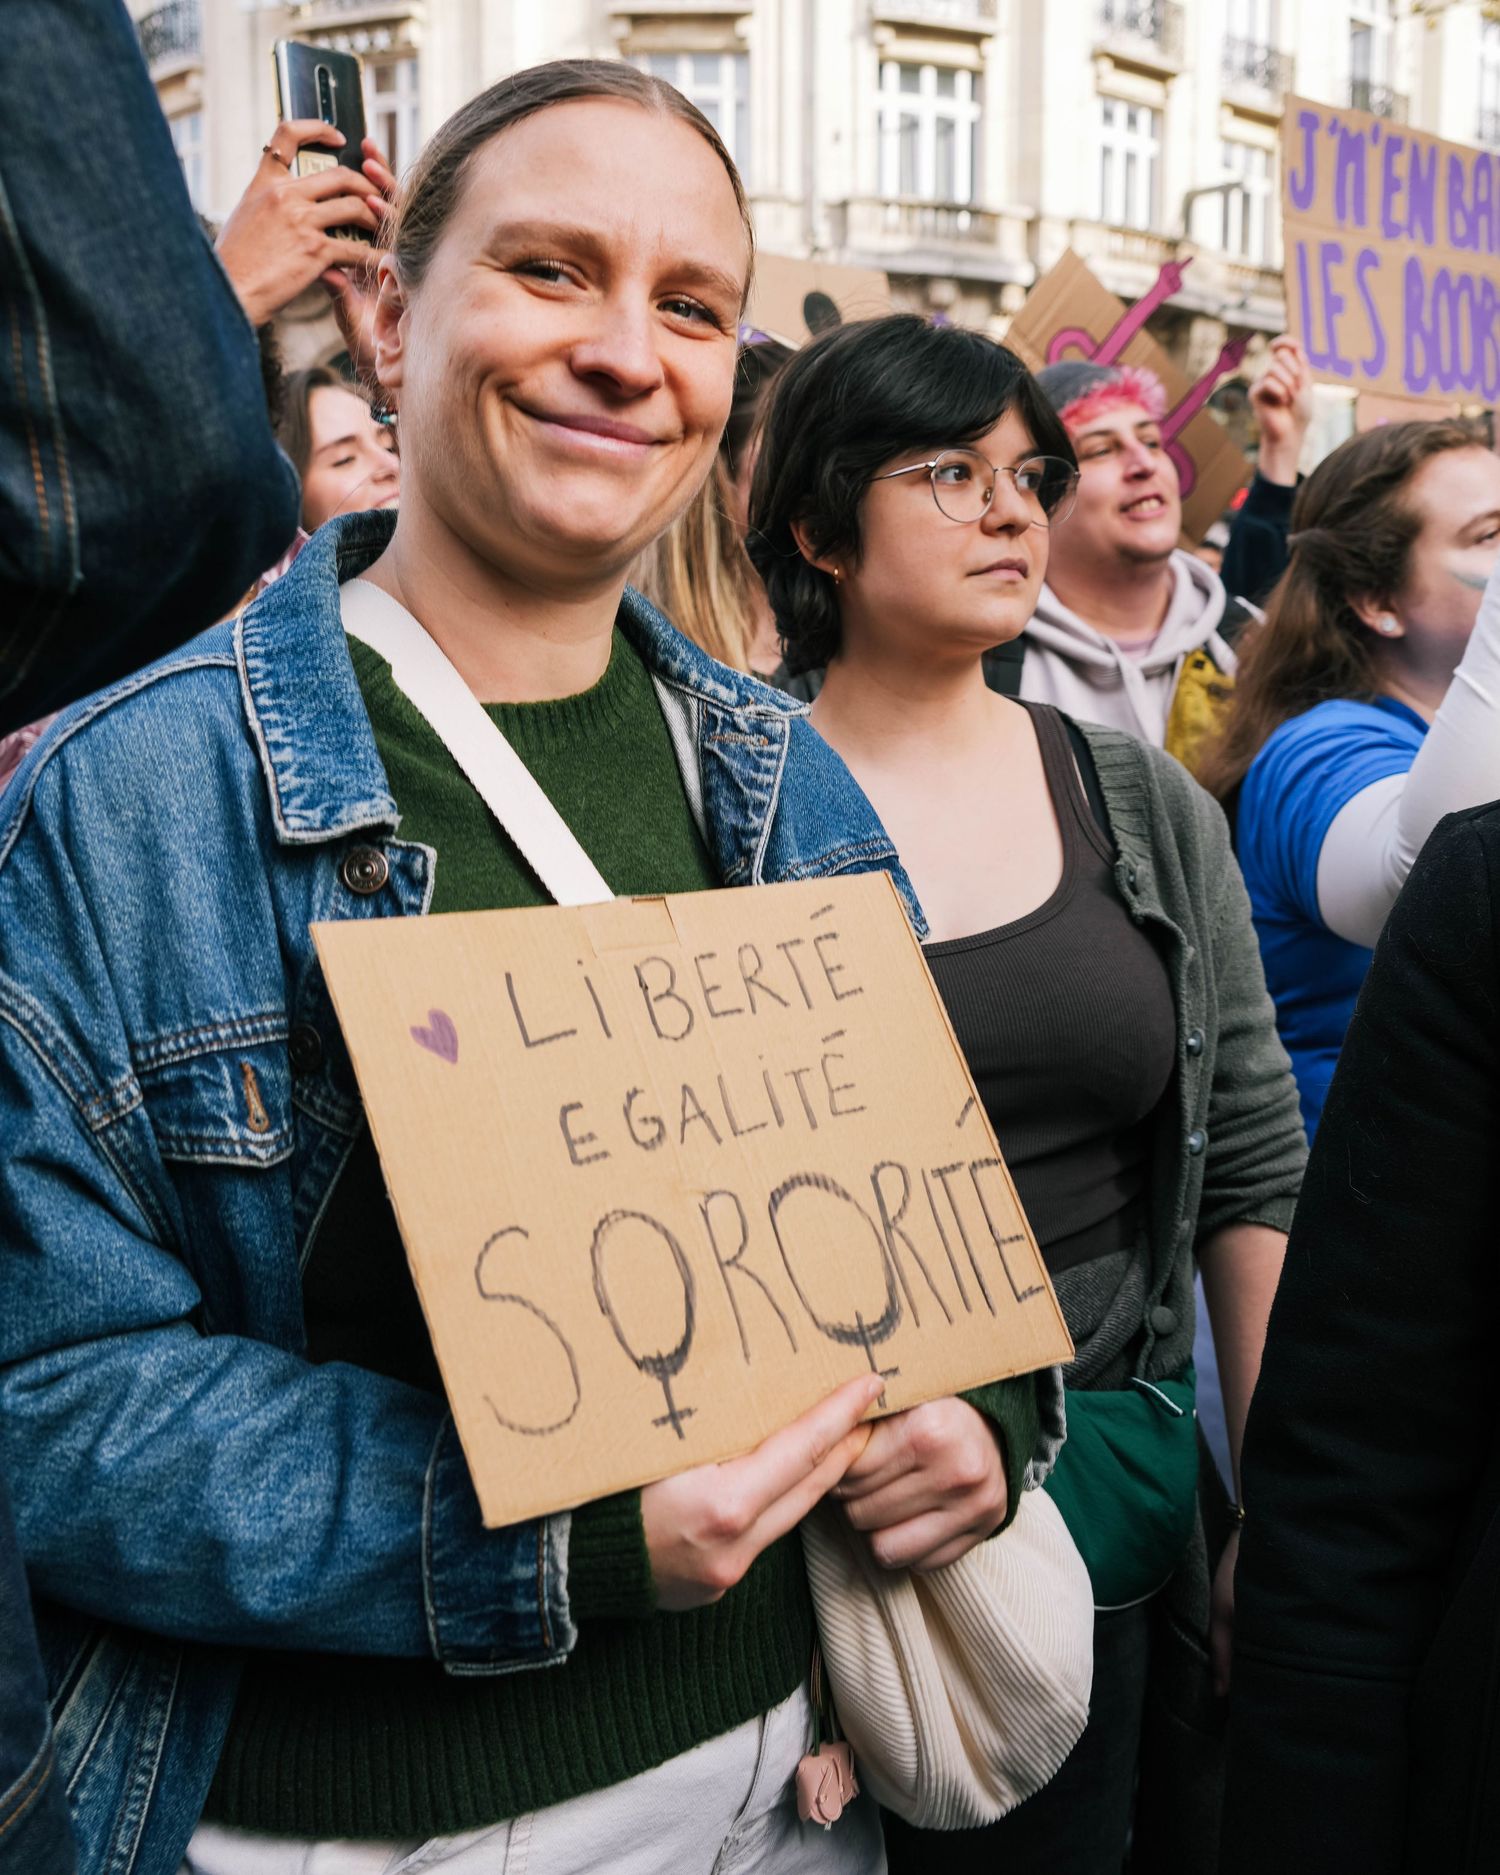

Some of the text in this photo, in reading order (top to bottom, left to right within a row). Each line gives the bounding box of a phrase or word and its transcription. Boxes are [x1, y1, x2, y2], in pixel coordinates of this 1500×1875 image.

[1447, 152, 1500, 255] BA
[1296, 241, 1387, 380] LES
[474, 1096, 1046, 1440] SORORITÉ
